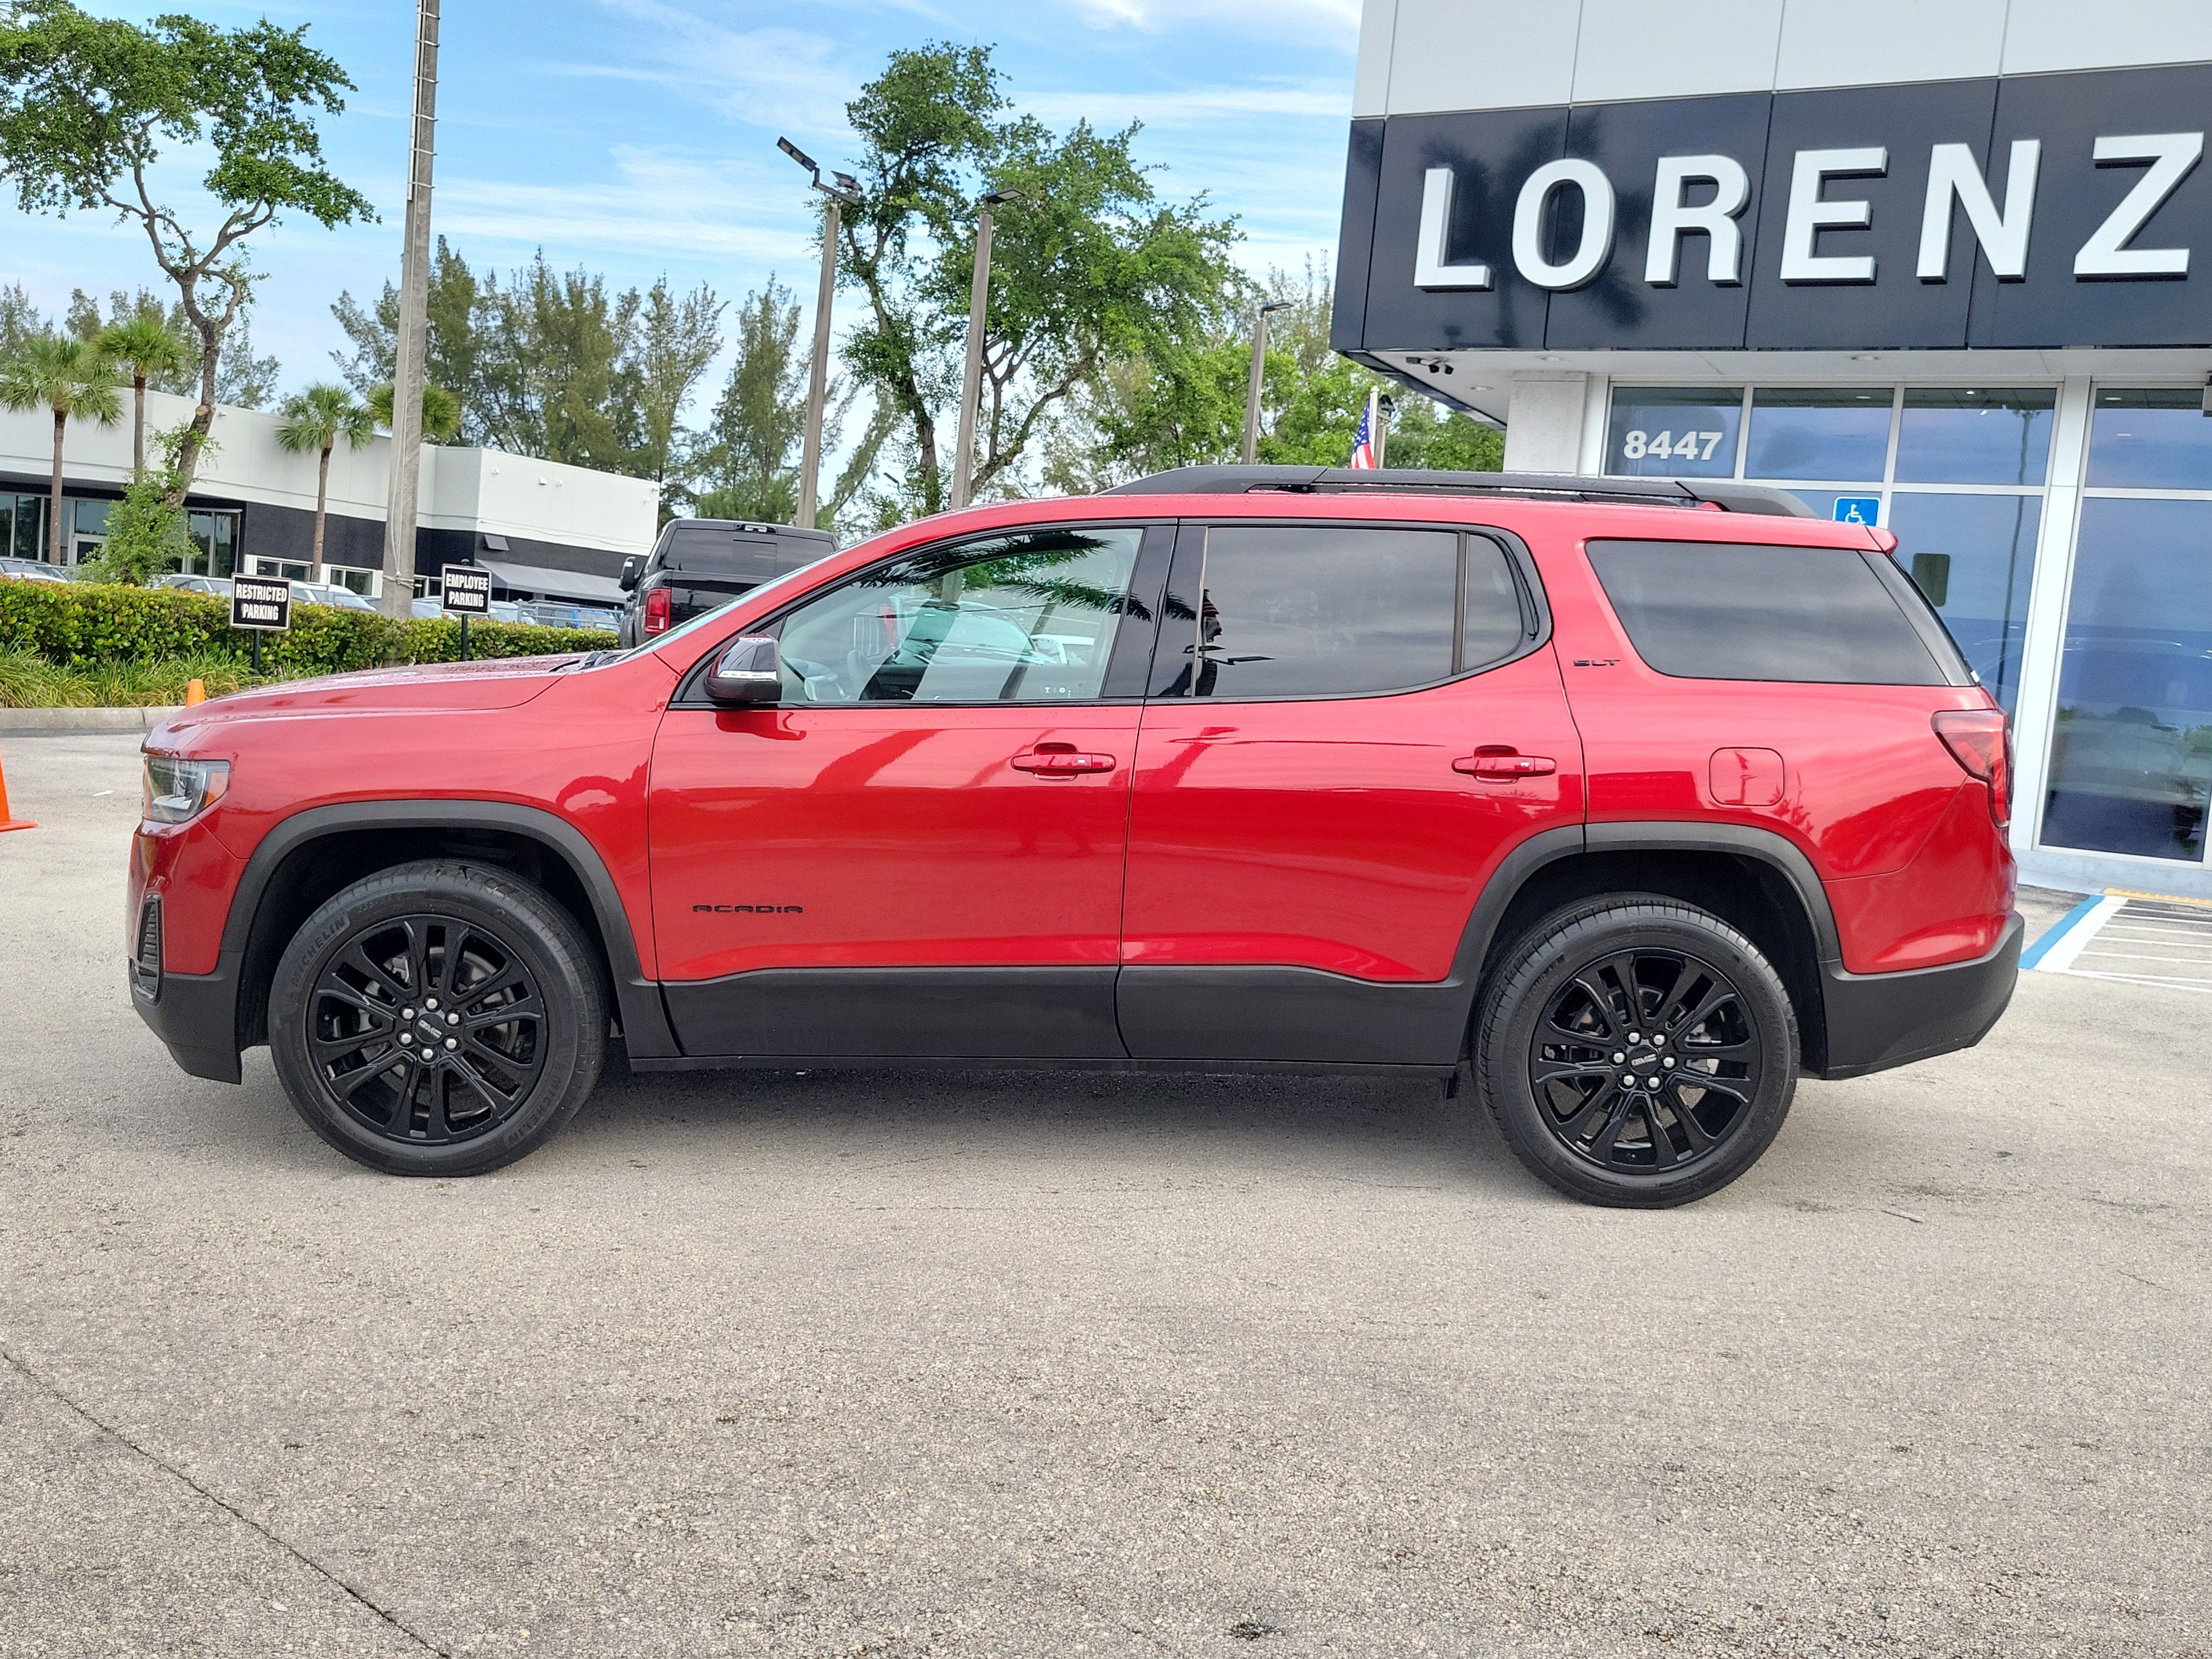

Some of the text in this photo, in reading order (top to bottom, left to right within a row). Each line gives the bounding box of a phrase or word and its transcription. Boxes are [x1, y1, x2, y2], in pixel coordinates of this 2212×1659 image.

[1414, 131, 2204, 290] LORENZ
[1623, 430, 1723, 461] 8447
[445, 573, 489, 591] EMPLOYEE
[235, 583, 288, 602] RESTRICTED
[448, 590, 484, 607] PARKING
[241, 603, 279, 620] PARKING
[692, 905, 803, 913] ACADIA
[290, 916, 347, 987] MICHELIN
[419, 1019, 442, 1039] GMC
[1631, 1054, 1657, 1066] GMC
